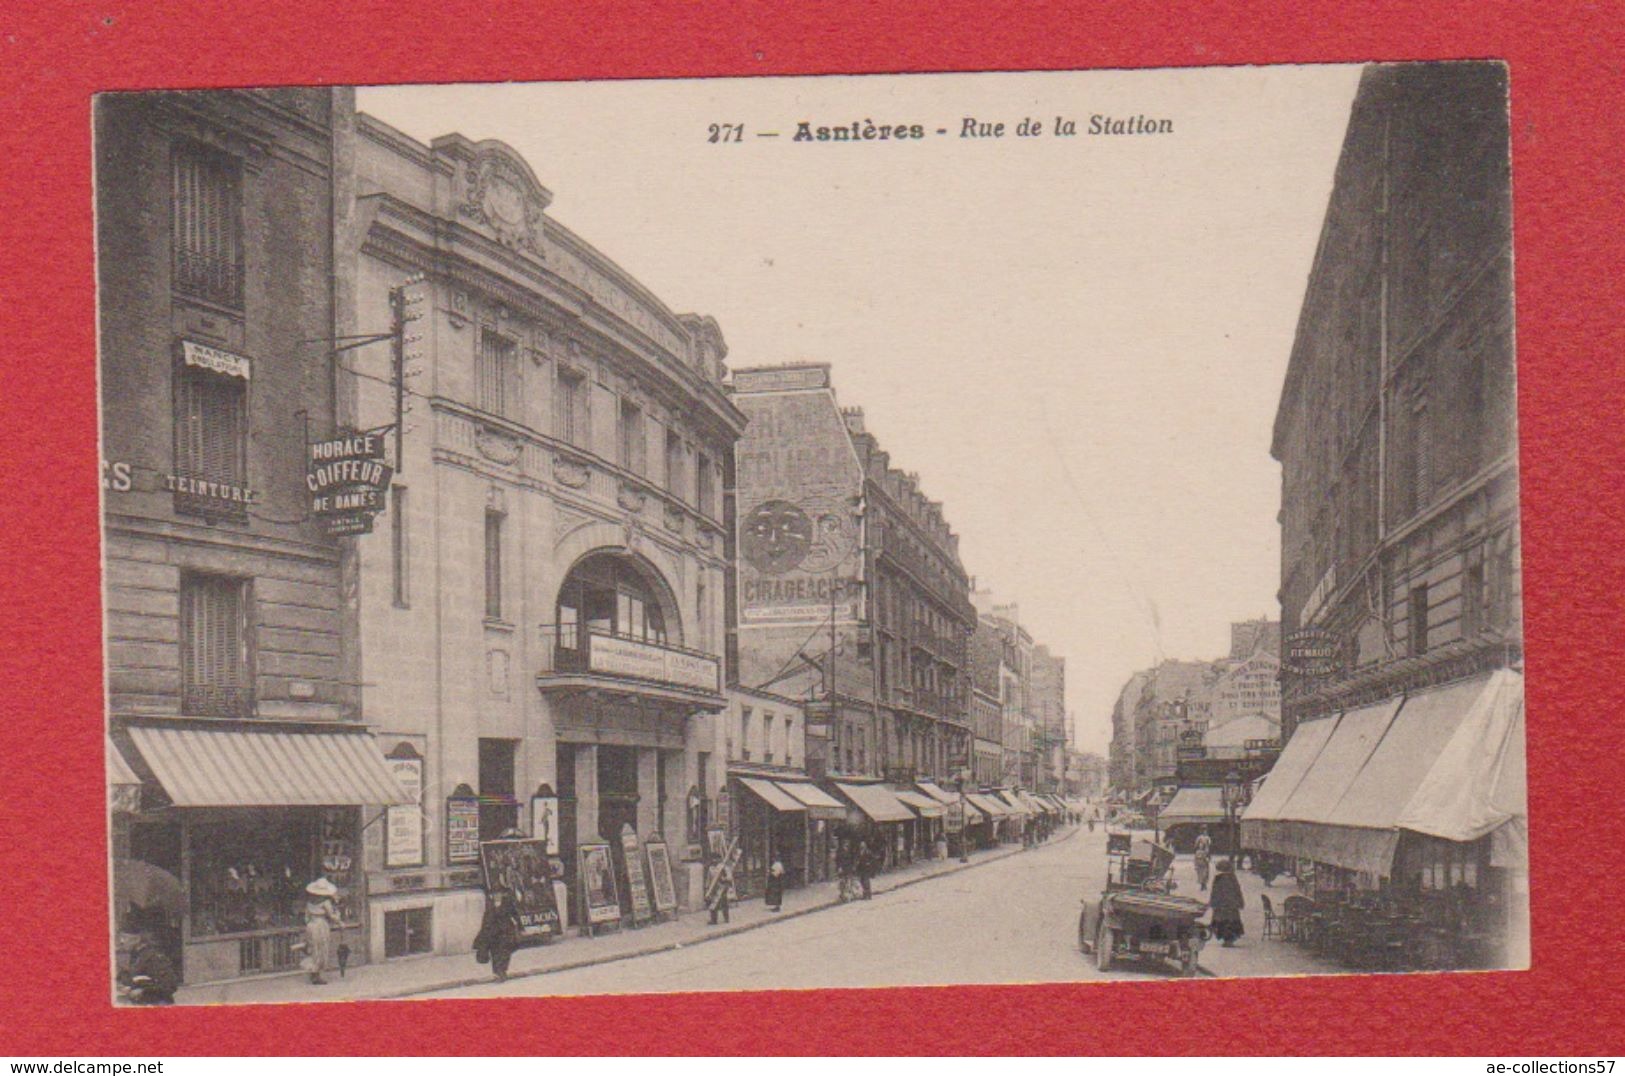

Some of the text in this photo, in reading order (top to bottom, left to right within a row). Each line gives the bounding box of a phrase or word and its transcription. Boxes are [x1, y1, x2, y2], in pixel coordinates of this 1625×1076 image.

[312, 437, 374, 460] HORACE
[306, 459, 383, 492] COIFFEUR
[166, 475, 253, 504] TEINTURE
[335, 491, 377, 510] DAMES
